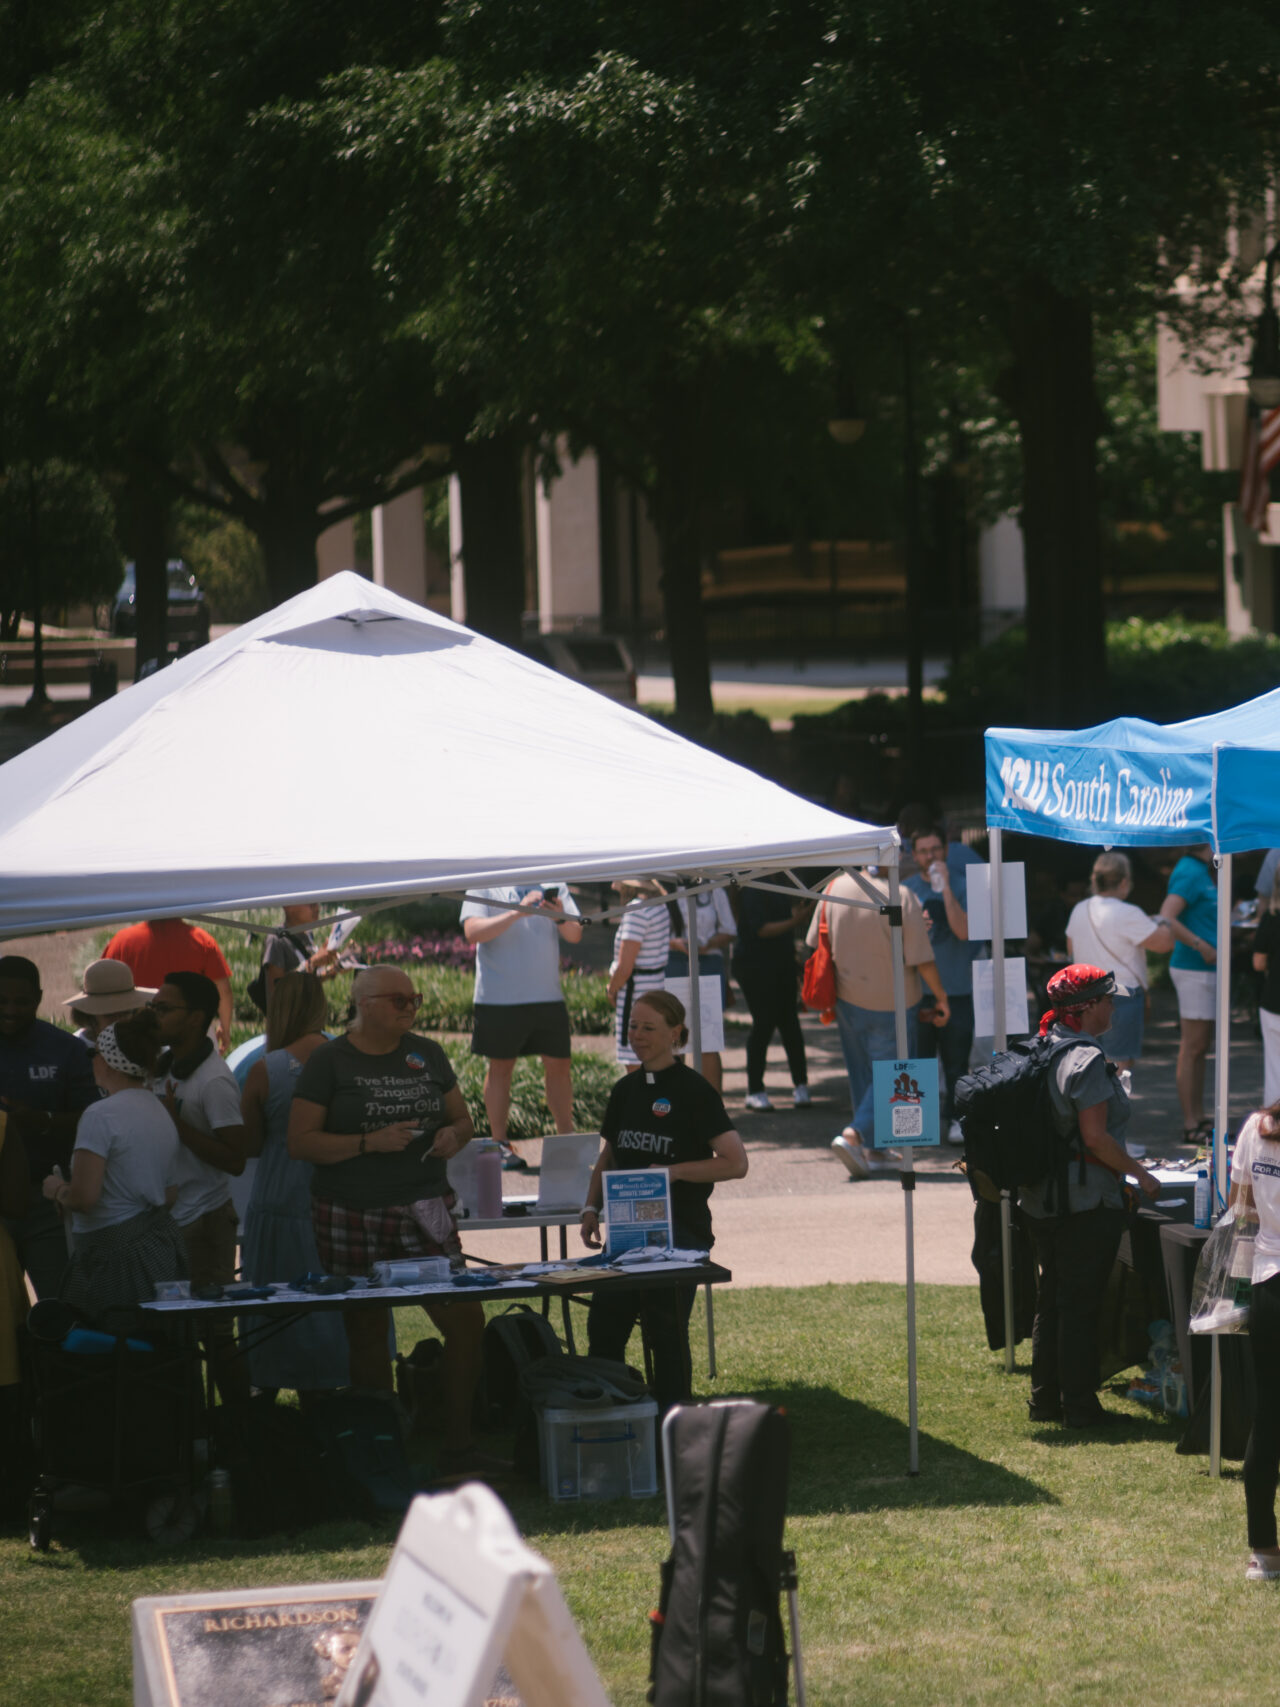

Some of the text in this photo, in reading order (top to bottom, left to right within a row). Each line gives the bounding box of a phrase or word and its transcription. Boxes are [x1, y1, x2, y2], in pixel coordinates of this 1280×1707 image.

[1043, 762, 1111, 822] South
[1114, 767, 1194, 828] Carolina
[29, 1066, 57, 1079] LDF
[382, 1072, 432, 1087] Heard
[370, 1083, 431, 1101] Enough
[364, 1098, 441, 1117] From Old
[1254, 1164, 1271, 1175] FOR
[205, 1607, 359, 1632] RICHARDSON
